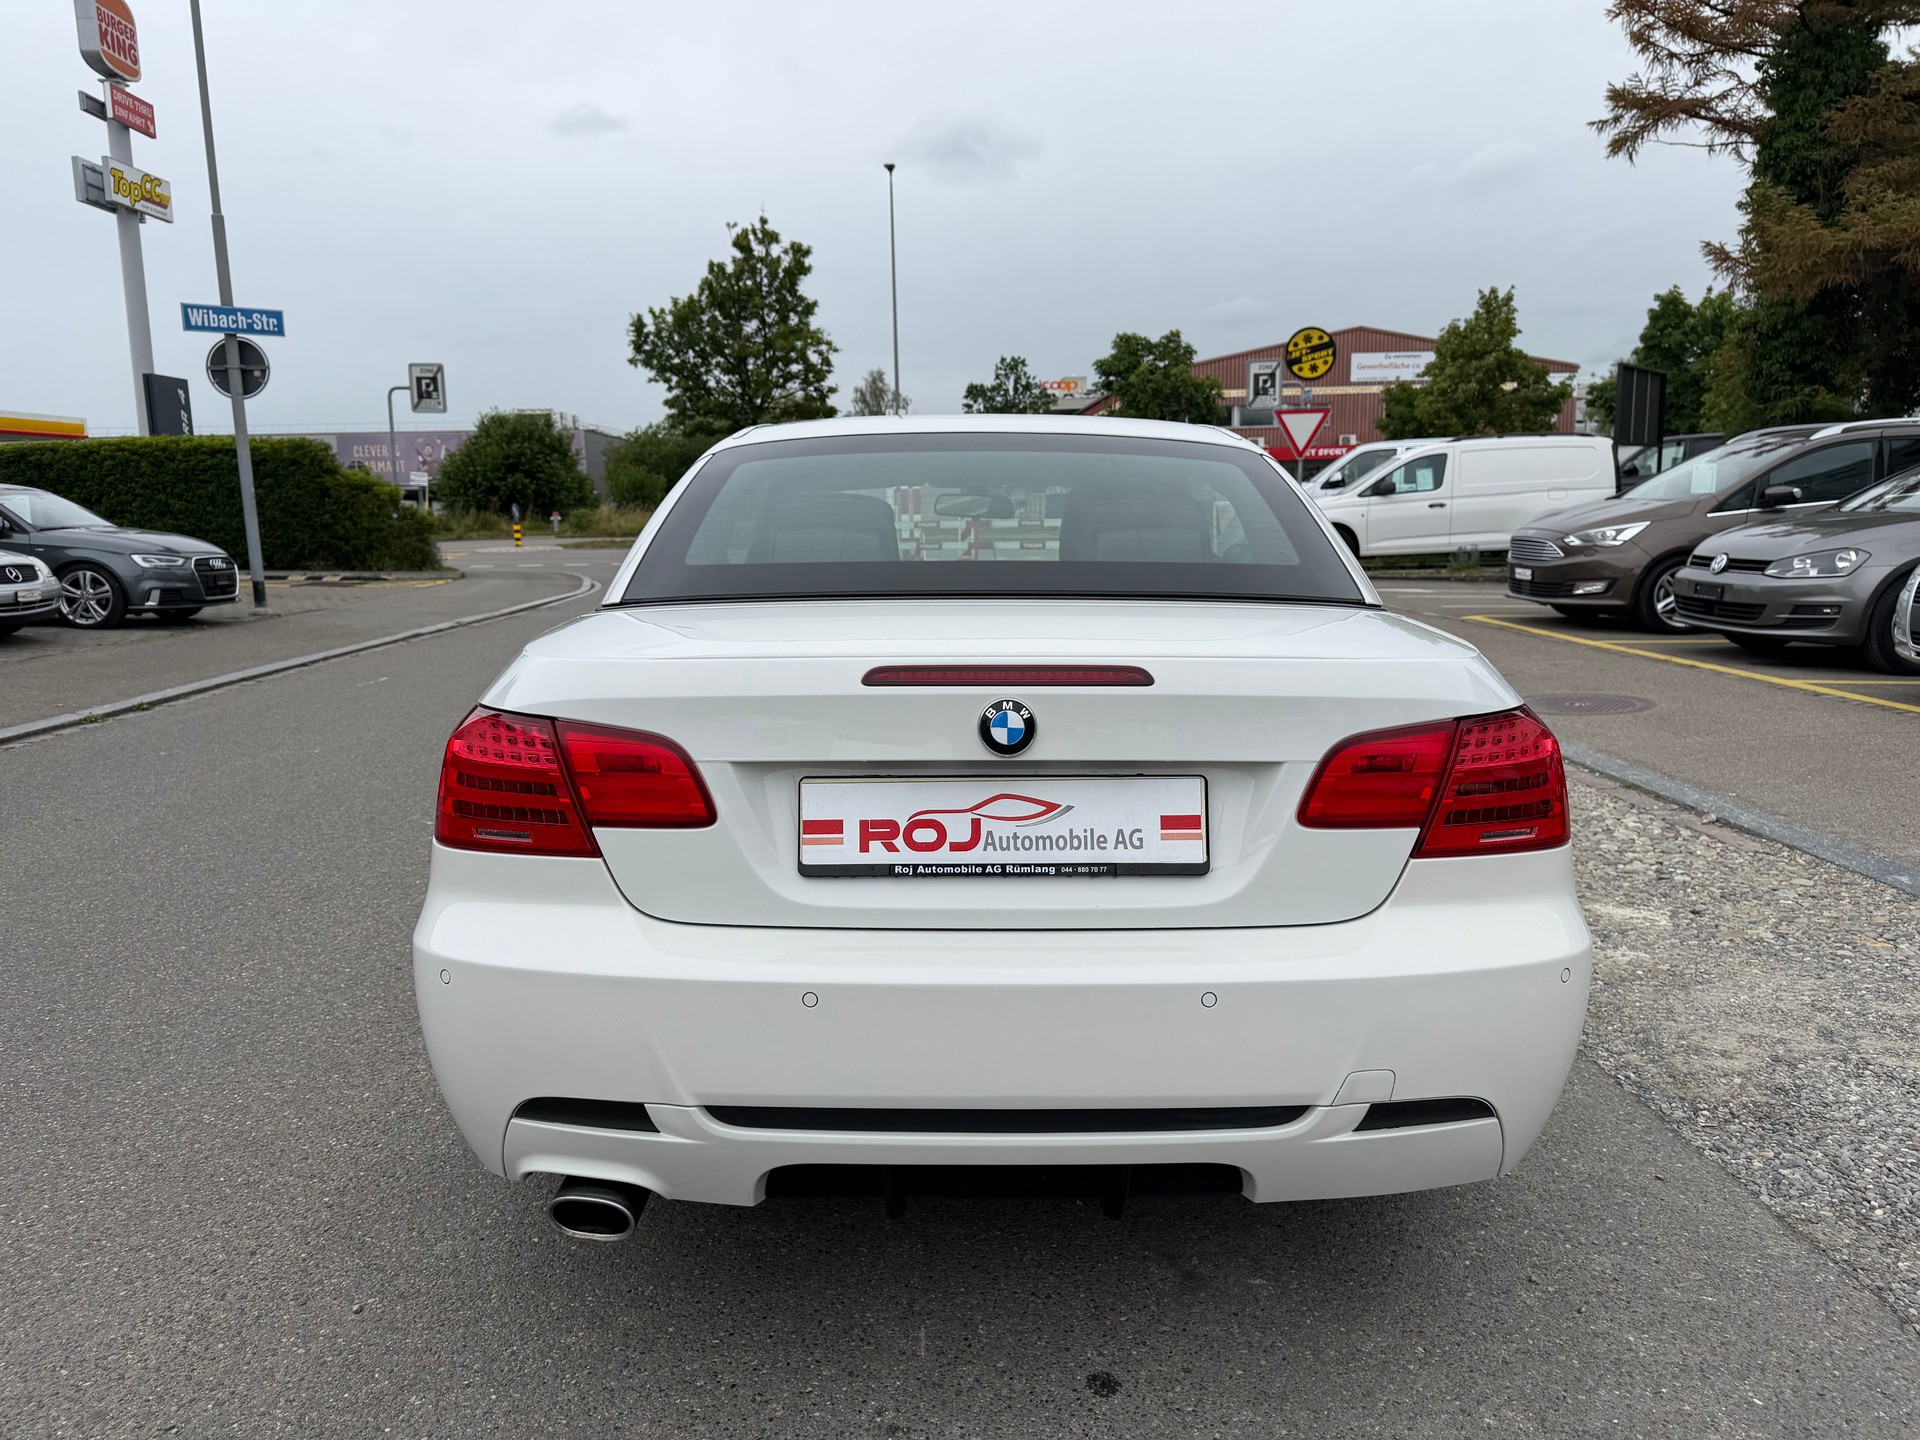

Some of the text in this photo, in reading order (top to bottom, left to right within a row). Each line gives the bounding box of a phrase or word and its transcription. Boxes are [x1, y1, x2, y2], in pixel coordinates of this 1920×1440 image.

[96, 6, 136, 44] BURGER
[98, 23, 138, 66] KING
[112, 89, 153, 117] DRIVE THRU
[114, 105, 146, 128] EINFAHRT
[110, 167, 162, 207] TopCC
[187, 307, 279, 332] Wibach-Str.
[1042, 380, 1079, 393] coop
[353, 444, 390, 458] CLEVER
[985, 701, 1031, 719] BMW
[859, 818, 1144, 853] ROJ Automobile AG
[894, 865, 913, 876] Roj
[917, 865, 983, 874] Automobile
[985, 865, 1002, 874] AG
[1006, 864, 1056, 875] Rümlang
